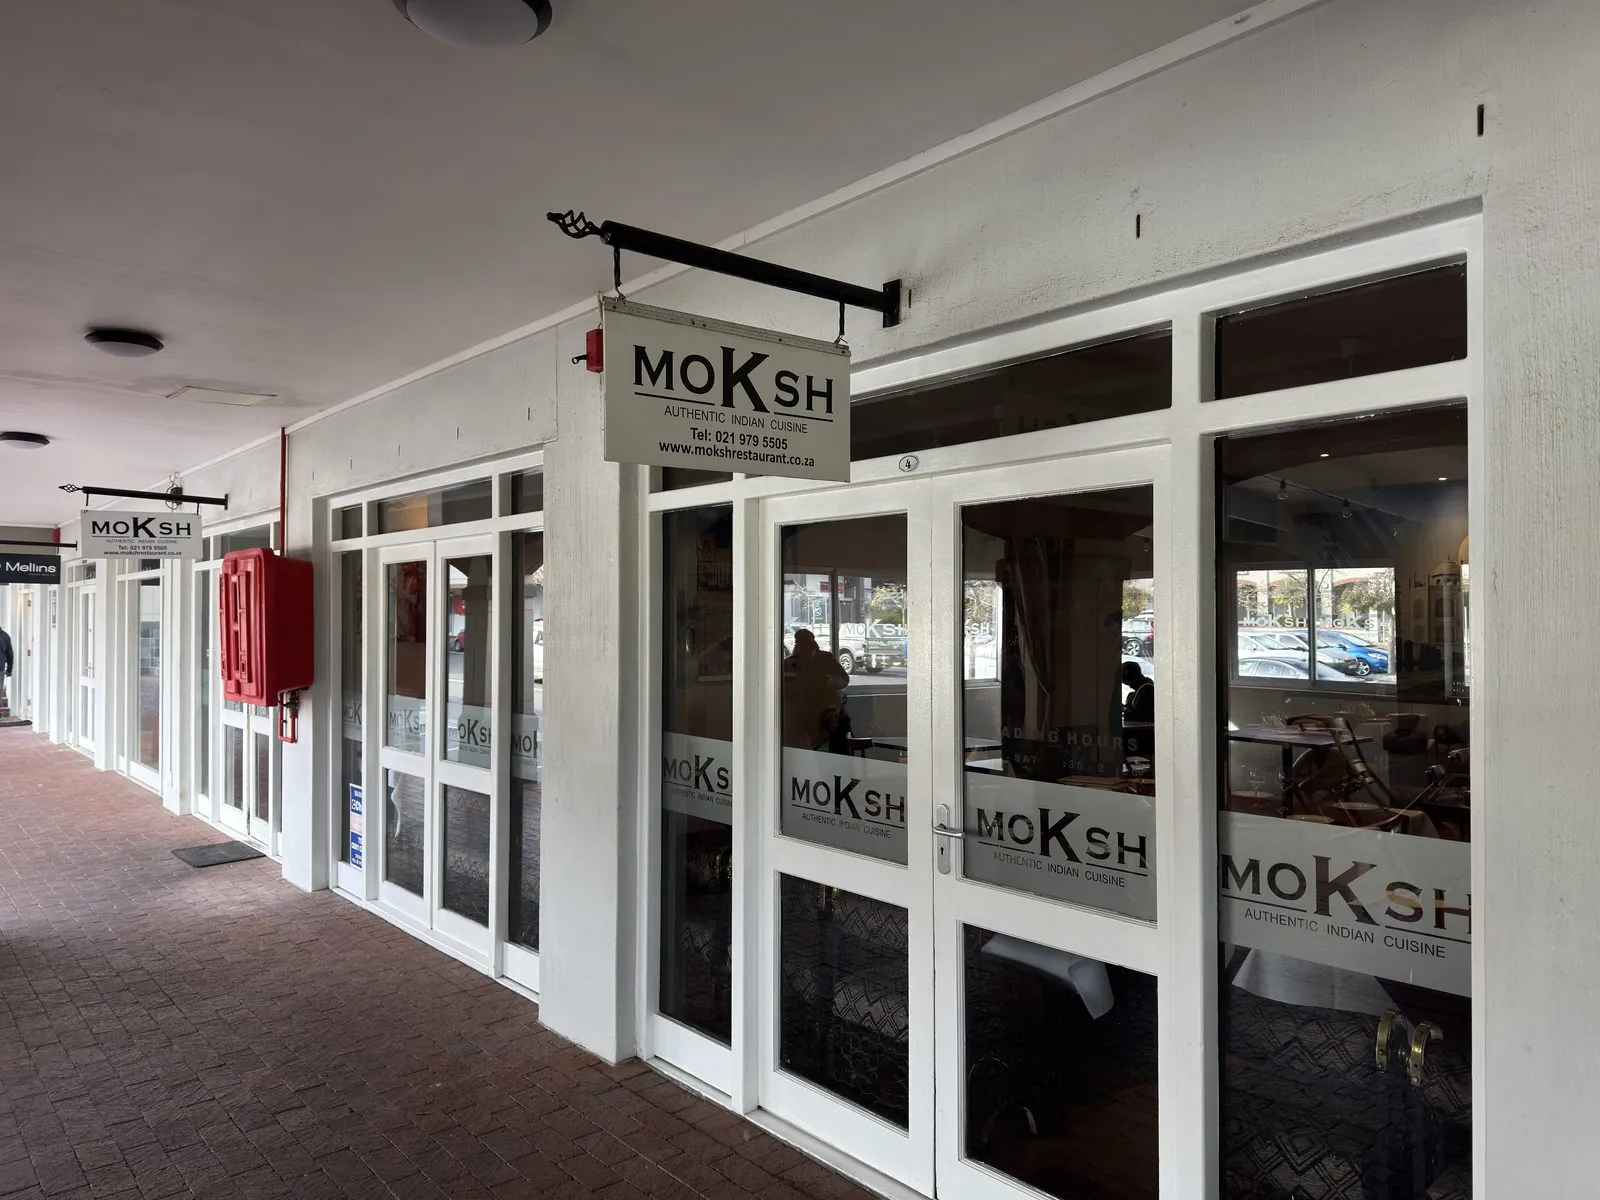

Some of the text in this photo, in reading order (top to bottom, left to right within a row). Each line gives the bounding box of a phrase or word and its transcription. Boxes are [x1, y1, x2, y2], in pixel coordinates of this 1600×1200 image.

[633, 344, 834, 414] MOKSH
[664, 405, 808, 434] AUTHENTIC INDIAN CUISINE
[690, 427, 788, 450] Tel: 021 979 5505
[659, 441, 815, 467] www.mokshrestaurant.co.za
[91, 516, 192, 538] MOKSH
[5, 561, 57, 573] Mellins
[389, 708, 420, 734] MOKS
[791, 774, 905, 823] MOKSH
[802, 811, 836, 827] AUTHENTIC
[864, 825, 892, 839] CUISINE
[976, 807, 1148, 869] MOKSH
[993, 851, 1126, 888] AUTHENTIC INDIAN CUISINE
[1219, 853, 1472, 935] MOKSH
[1244, 907, 1447, 959] AUTHENTIC INDIAN CUISINE
